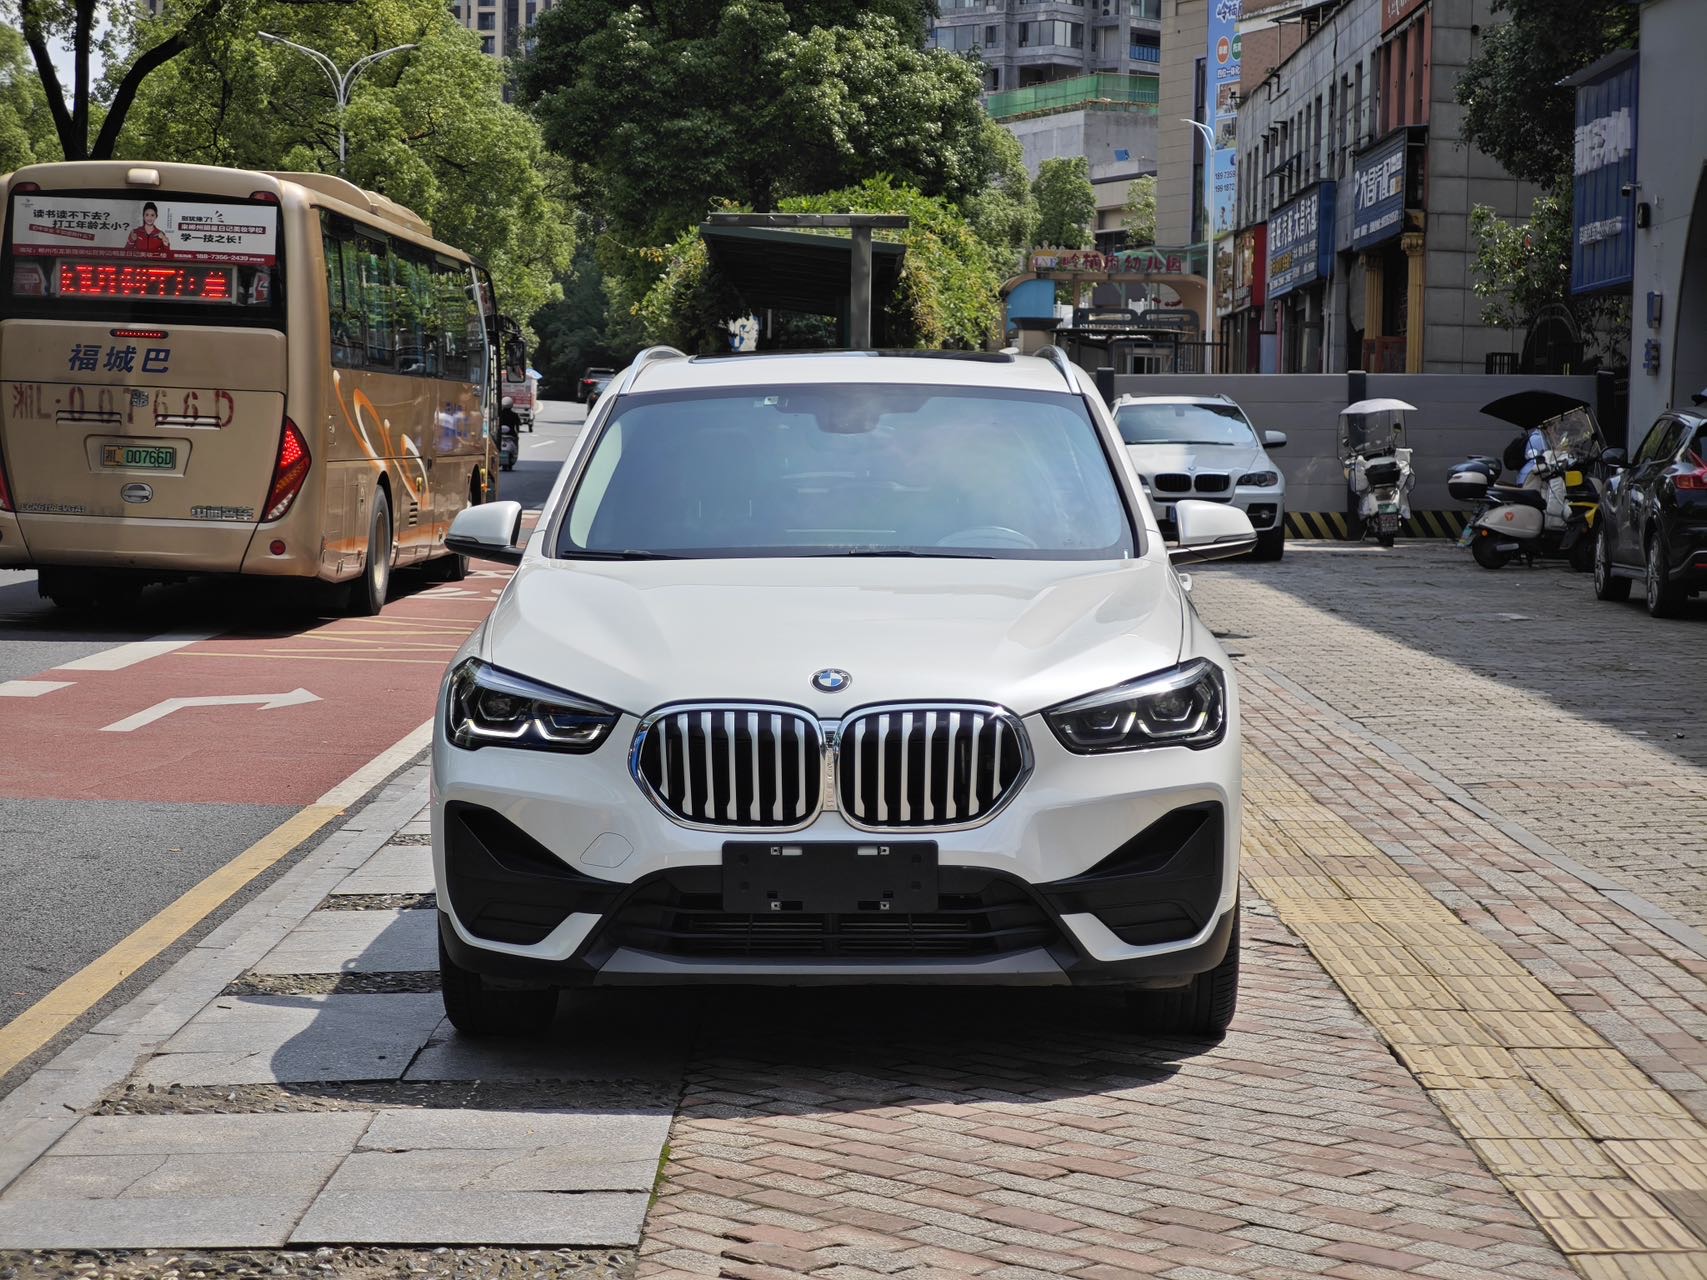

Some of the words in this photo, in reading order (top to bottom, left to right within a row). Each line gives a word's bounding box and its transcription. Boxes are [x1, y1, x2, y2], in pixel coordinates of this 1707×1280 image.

[33, 209, 110, 220] 读书读不下去？
[52, 219, 130, 231] 打工年龄太小？
[180, 233, 242, 244] 学一技之长！
[69, 344, 170, 373] 福城巴
